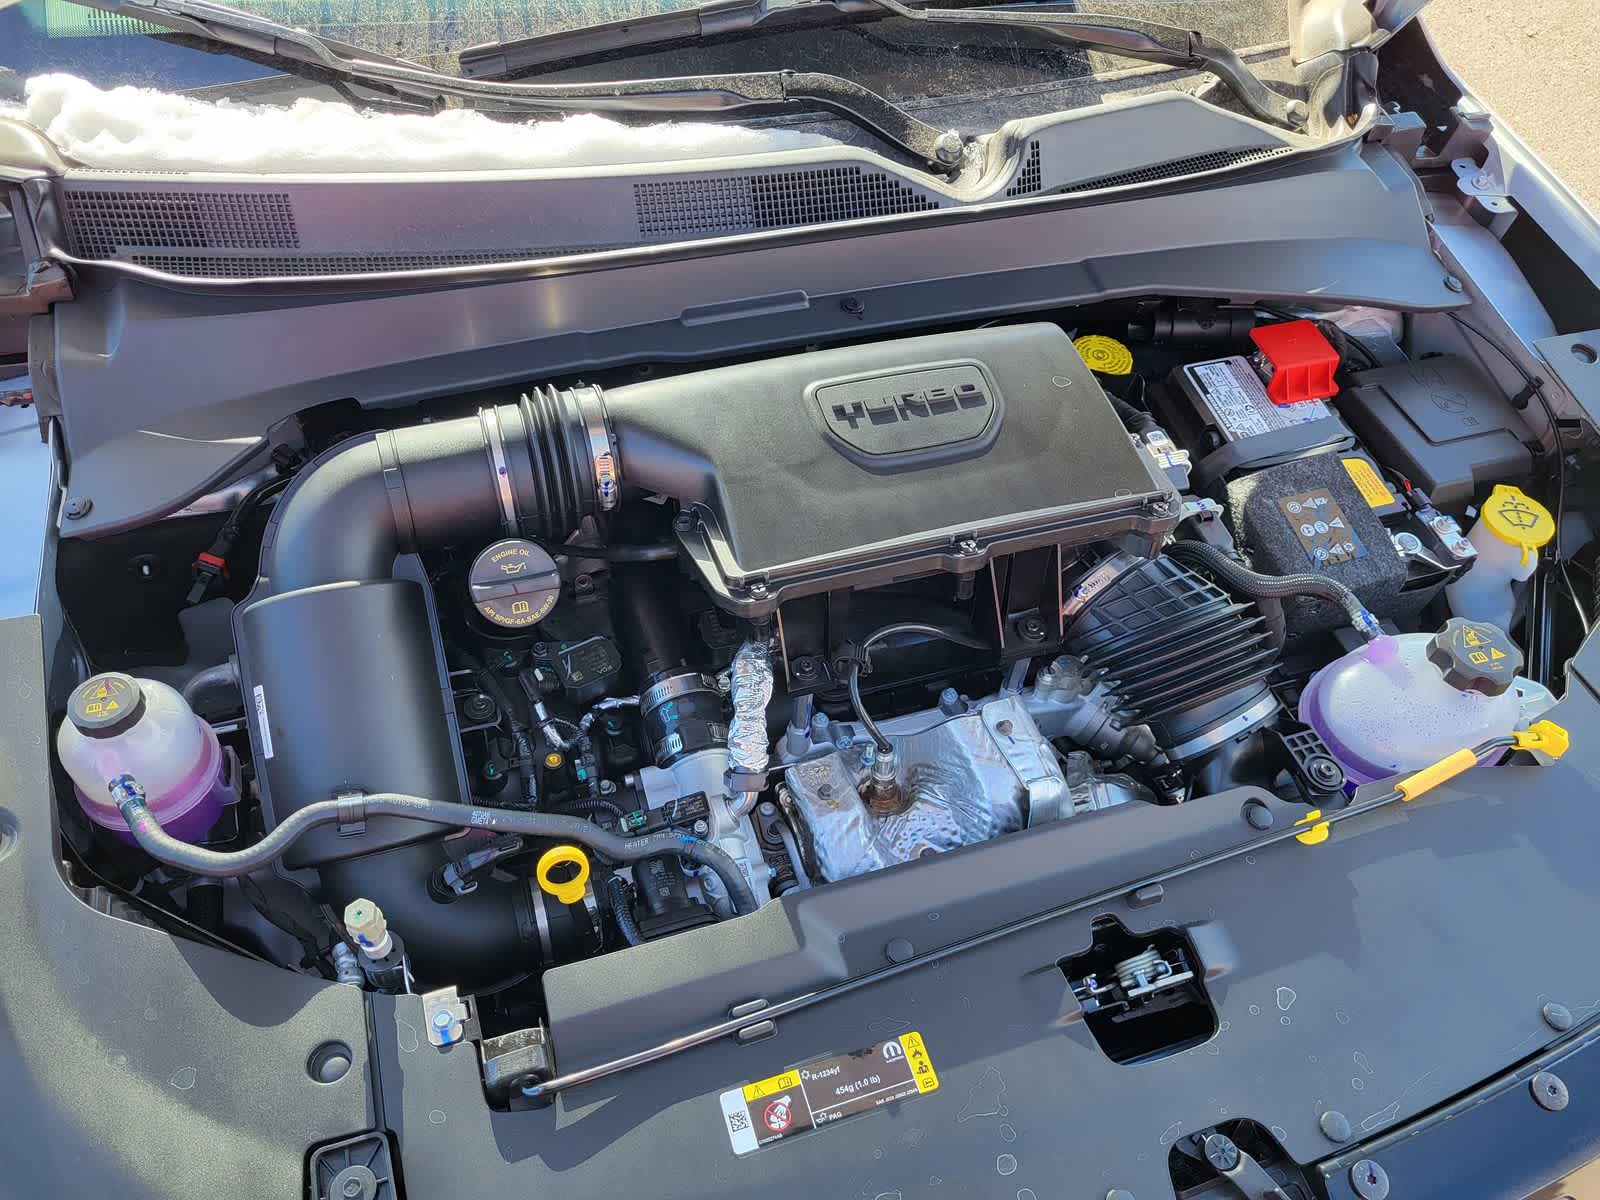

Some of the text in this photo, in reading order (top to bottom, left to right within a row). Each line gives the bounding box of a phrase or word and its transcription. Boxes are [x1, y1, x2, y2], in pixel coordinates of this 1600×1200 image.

[491, 548, 531, 563] ENGINE OIL
[484, 606, 496, 617] API
[624, 837, 649, 849] HEATER
[811, 1065, 841, 1081] R-1234yf
[835, 1074, 881, 1095] 454g (1.0 lb)
[828, 1111, 843, 1121] PAG
